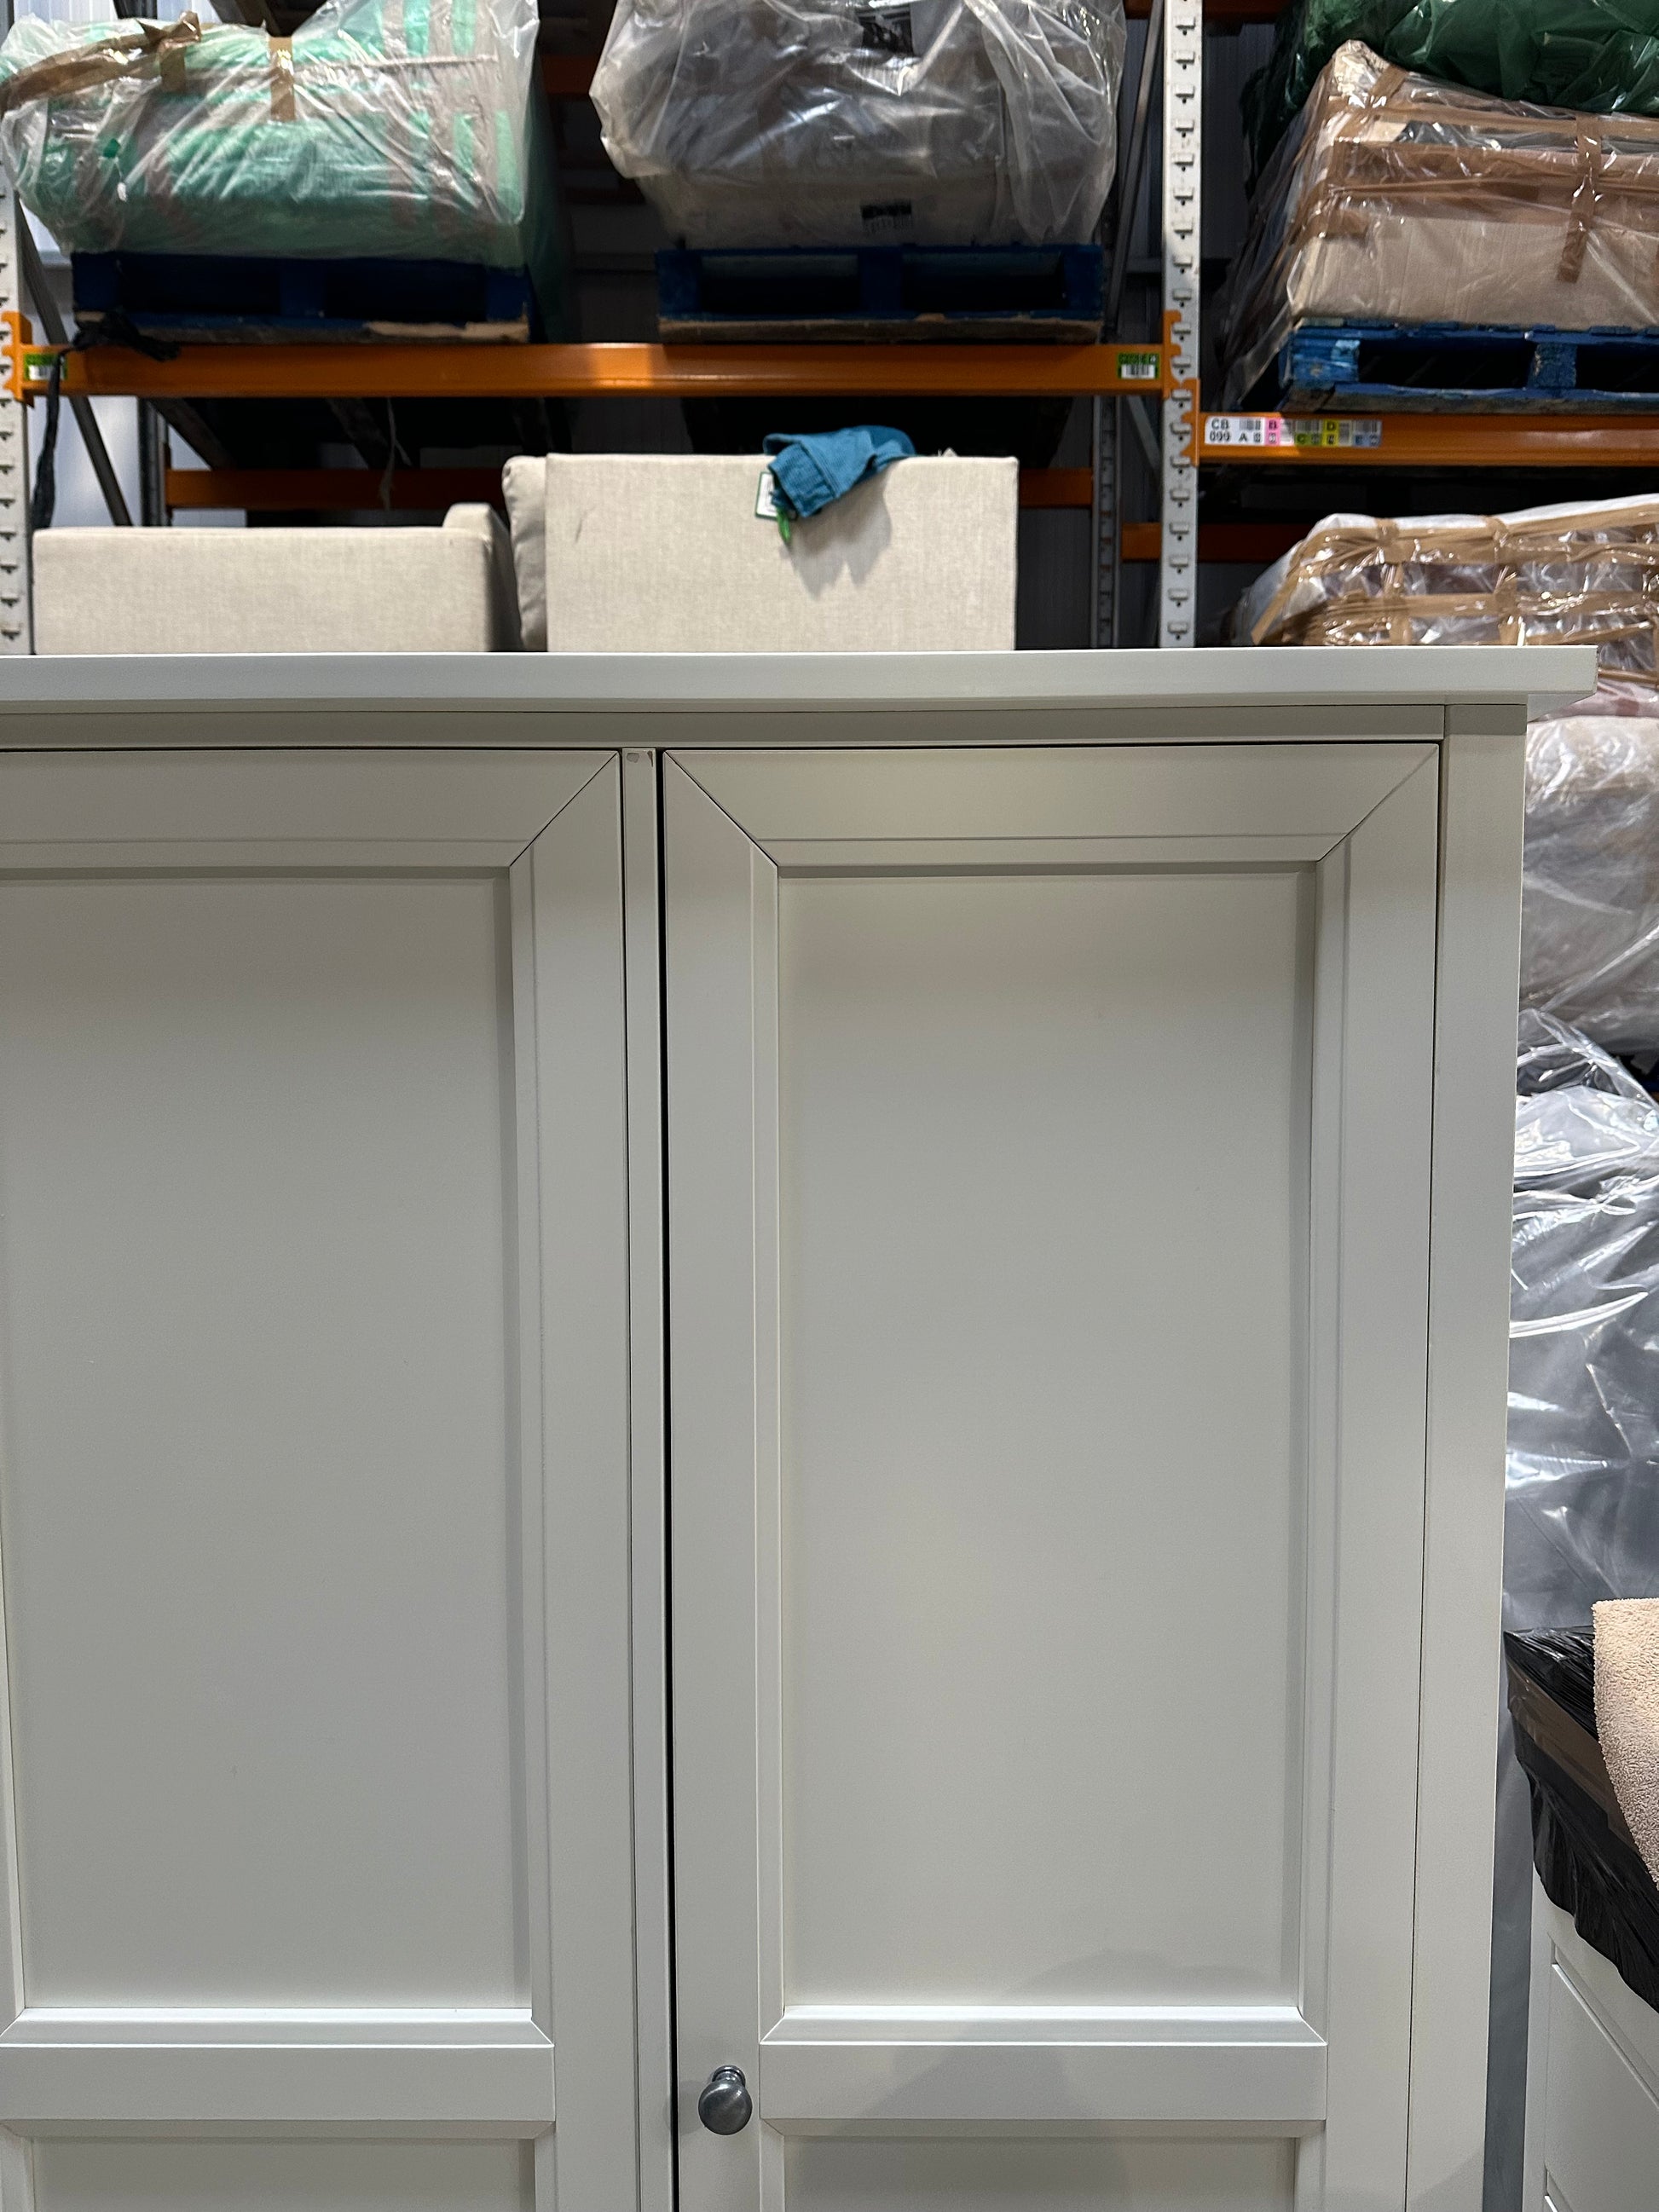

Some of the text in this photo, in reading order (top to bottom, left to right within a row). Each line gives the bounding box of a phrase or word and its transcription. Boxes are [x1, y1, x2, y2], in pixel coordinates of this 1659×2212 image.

[1211, 418, 1229, 430] CB
[1209, 430, 1230, 442] 099
[1239, 432, 1247, 442] A
